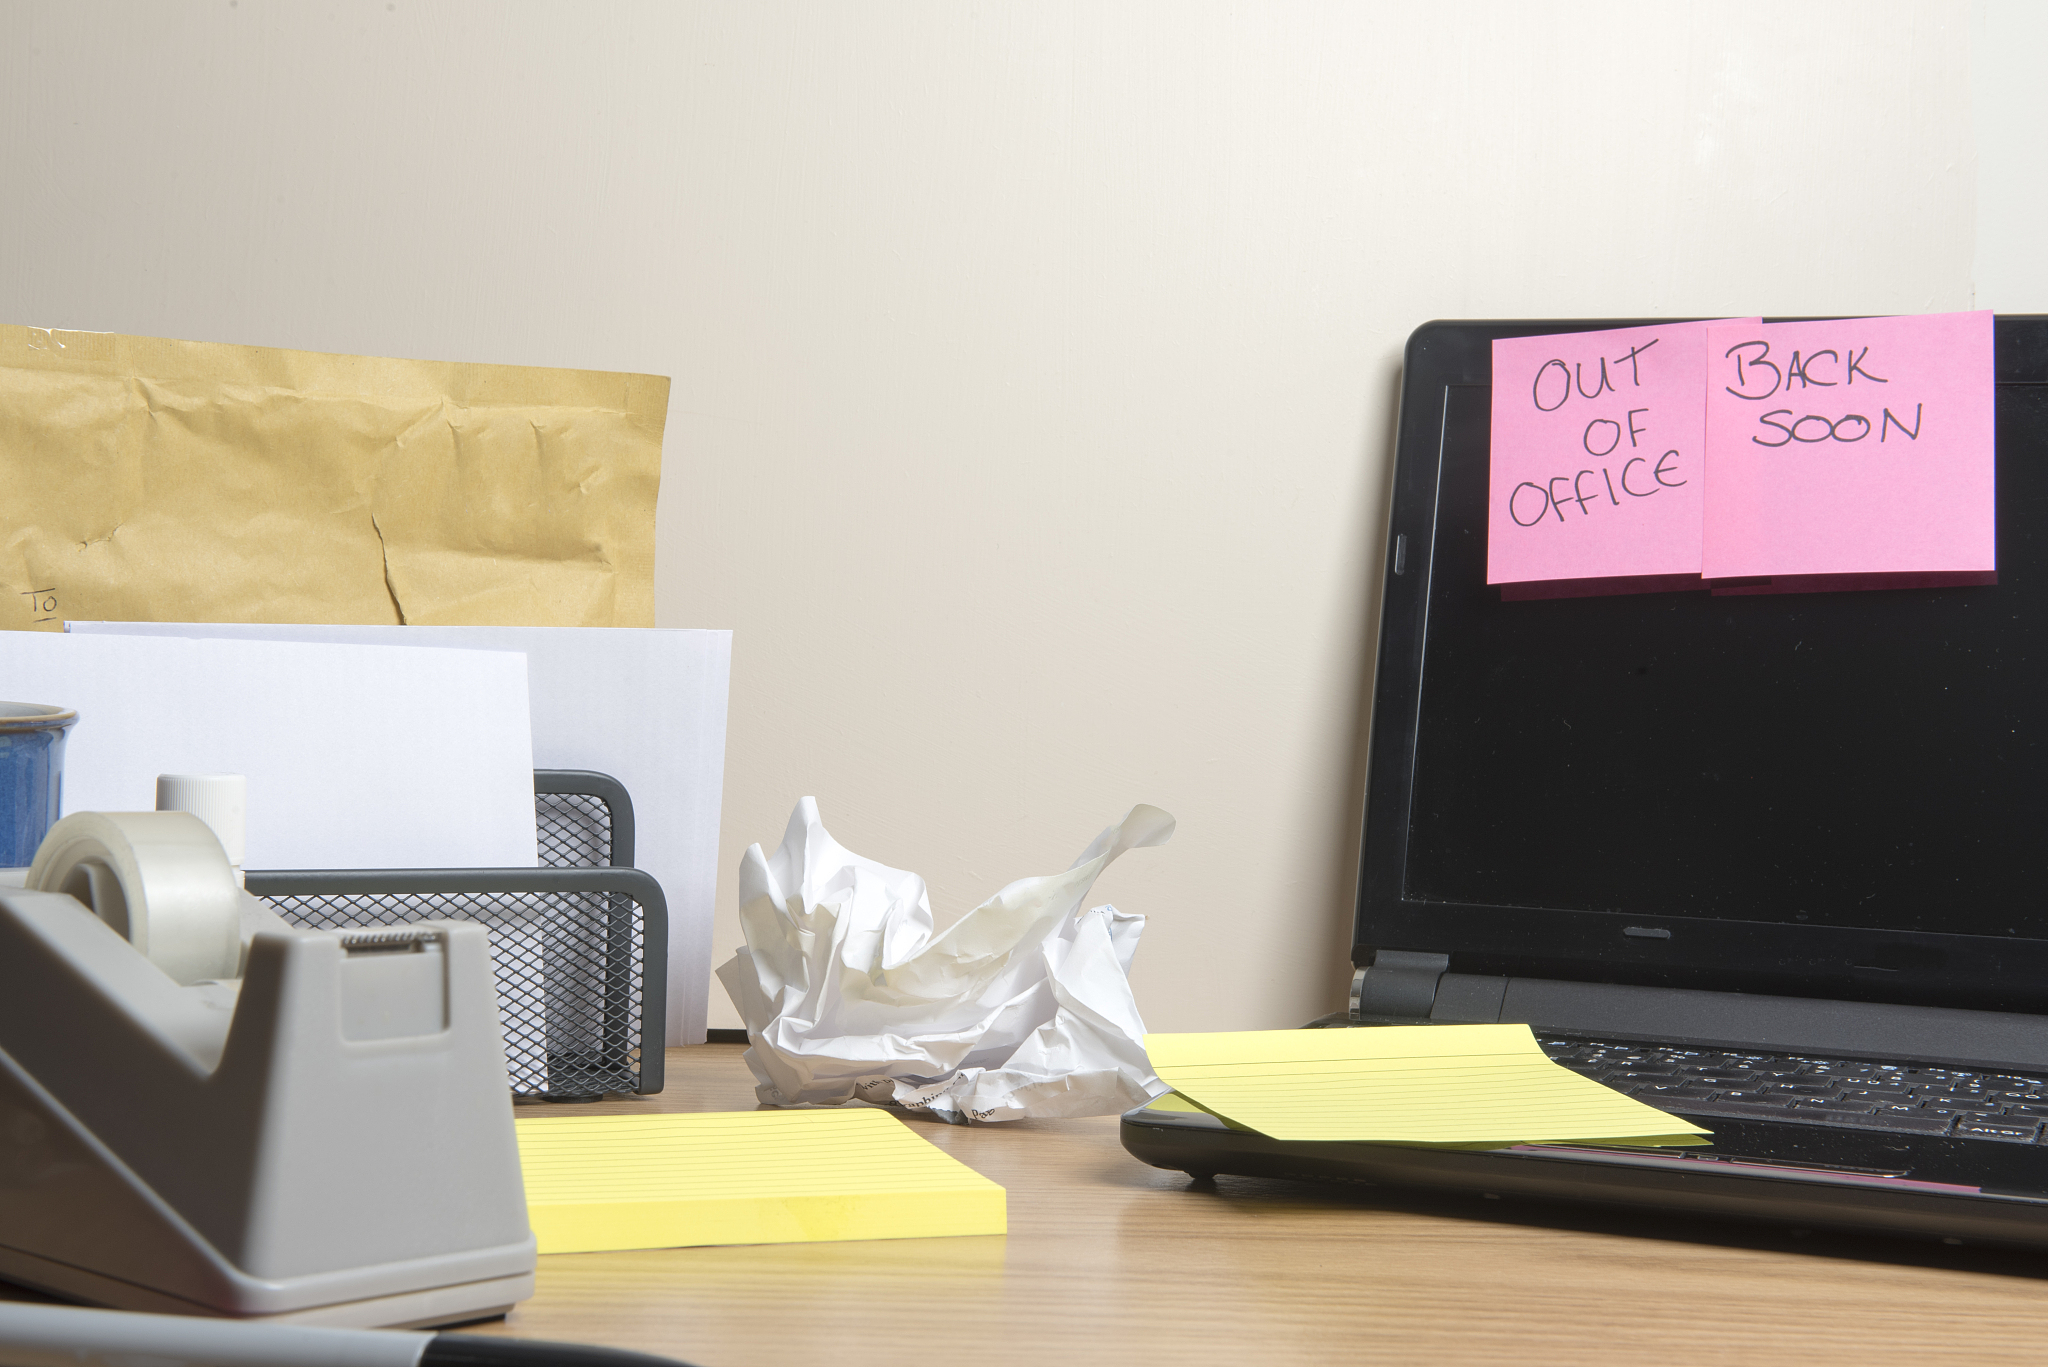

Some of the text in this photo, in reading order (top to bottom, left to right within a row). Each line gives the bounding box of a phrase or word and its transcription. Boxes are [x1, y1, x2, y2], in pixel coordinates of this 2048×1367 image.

[1533, 338, 1659, 412] OUT
[1725, 340, 1888, 400] BACK
[1583, 408, 1650, 456] OF
[1752, 403, 1922, 447] SOON
[1509, 450, 1688, 527] OFFICE
